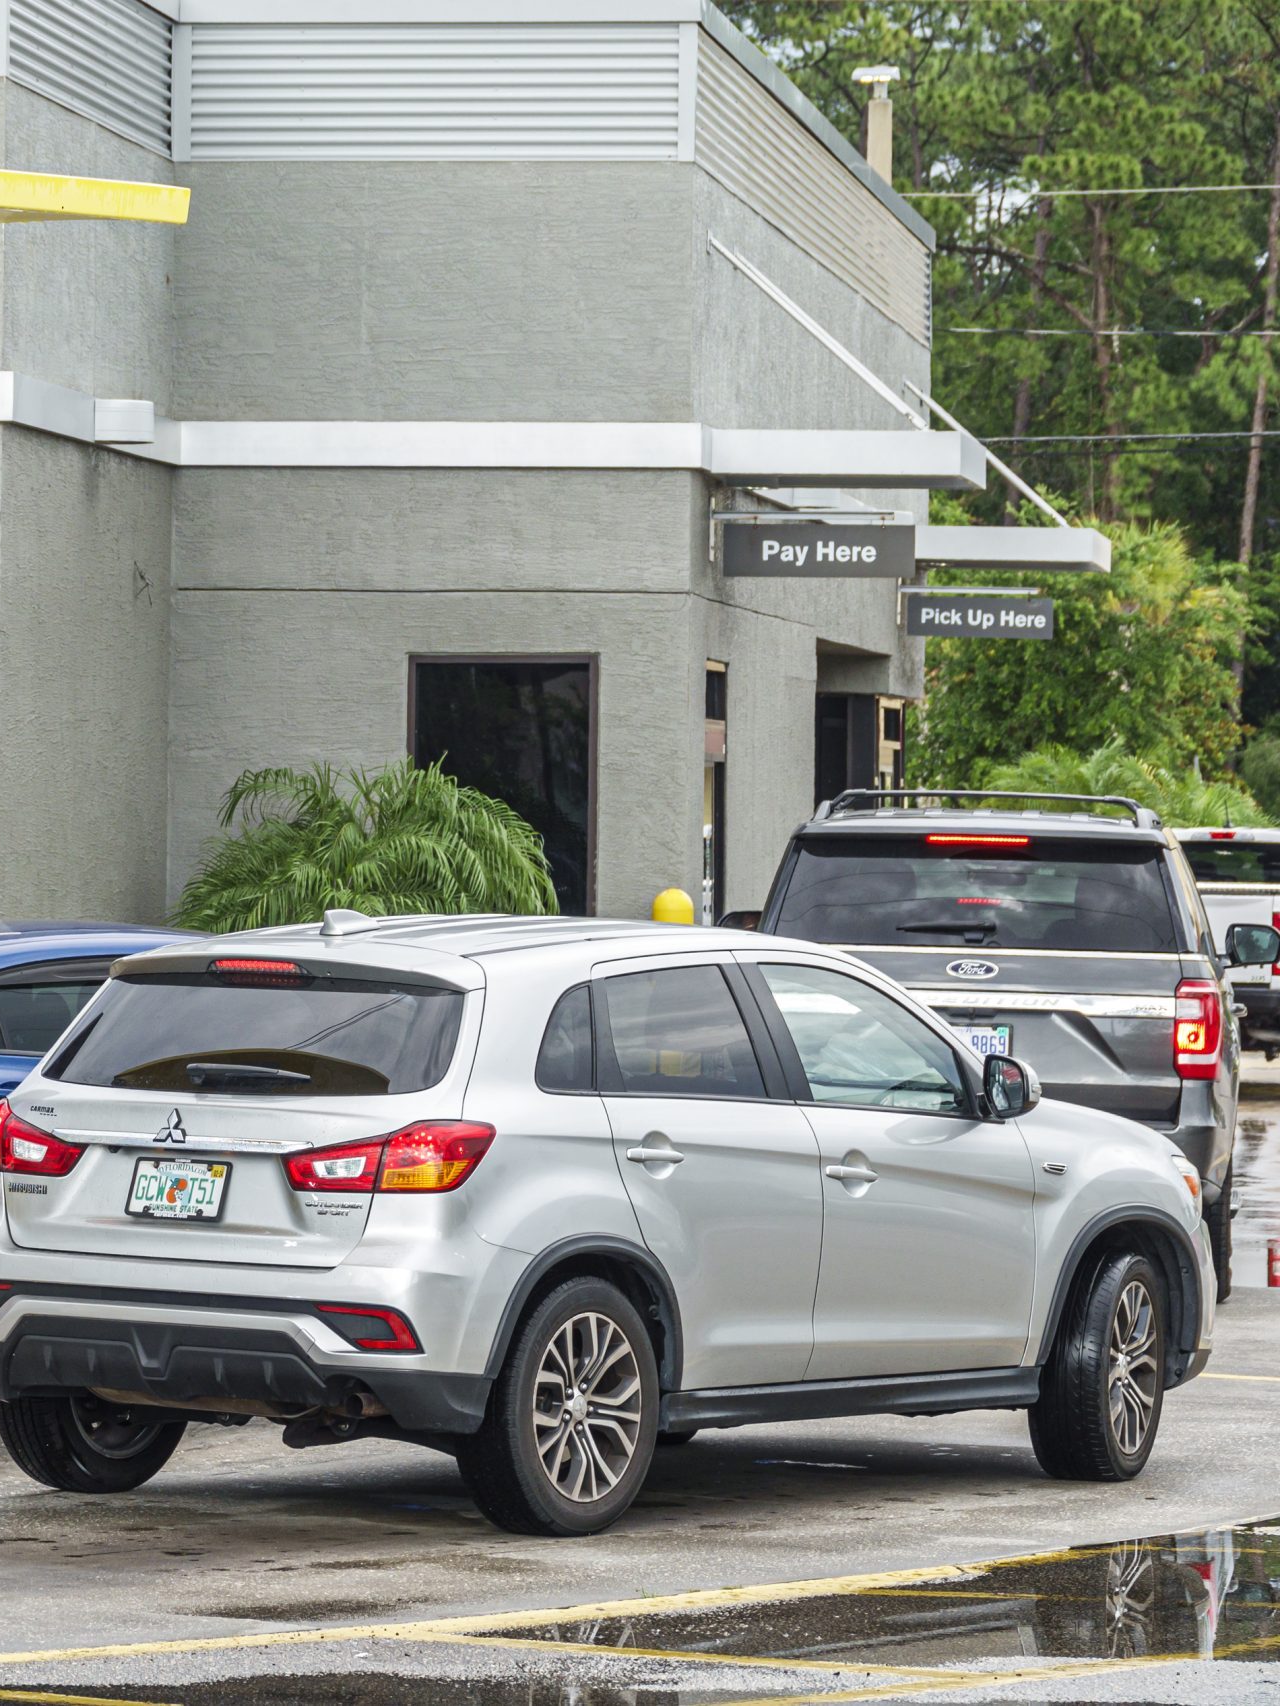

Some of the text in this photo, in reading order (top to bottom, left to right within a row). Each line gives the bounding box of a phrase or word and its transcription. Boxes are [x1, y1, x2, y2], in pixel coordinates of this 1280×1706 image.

[762, 541, 877, 566] Pay Here
[921, 608, 1046, 630] Pick Up Here
[958, 962, 987, 975] Ford
[972, 1035, 1006, 1054] 9869
[135, 1175, 216, 1205] GCW T51
